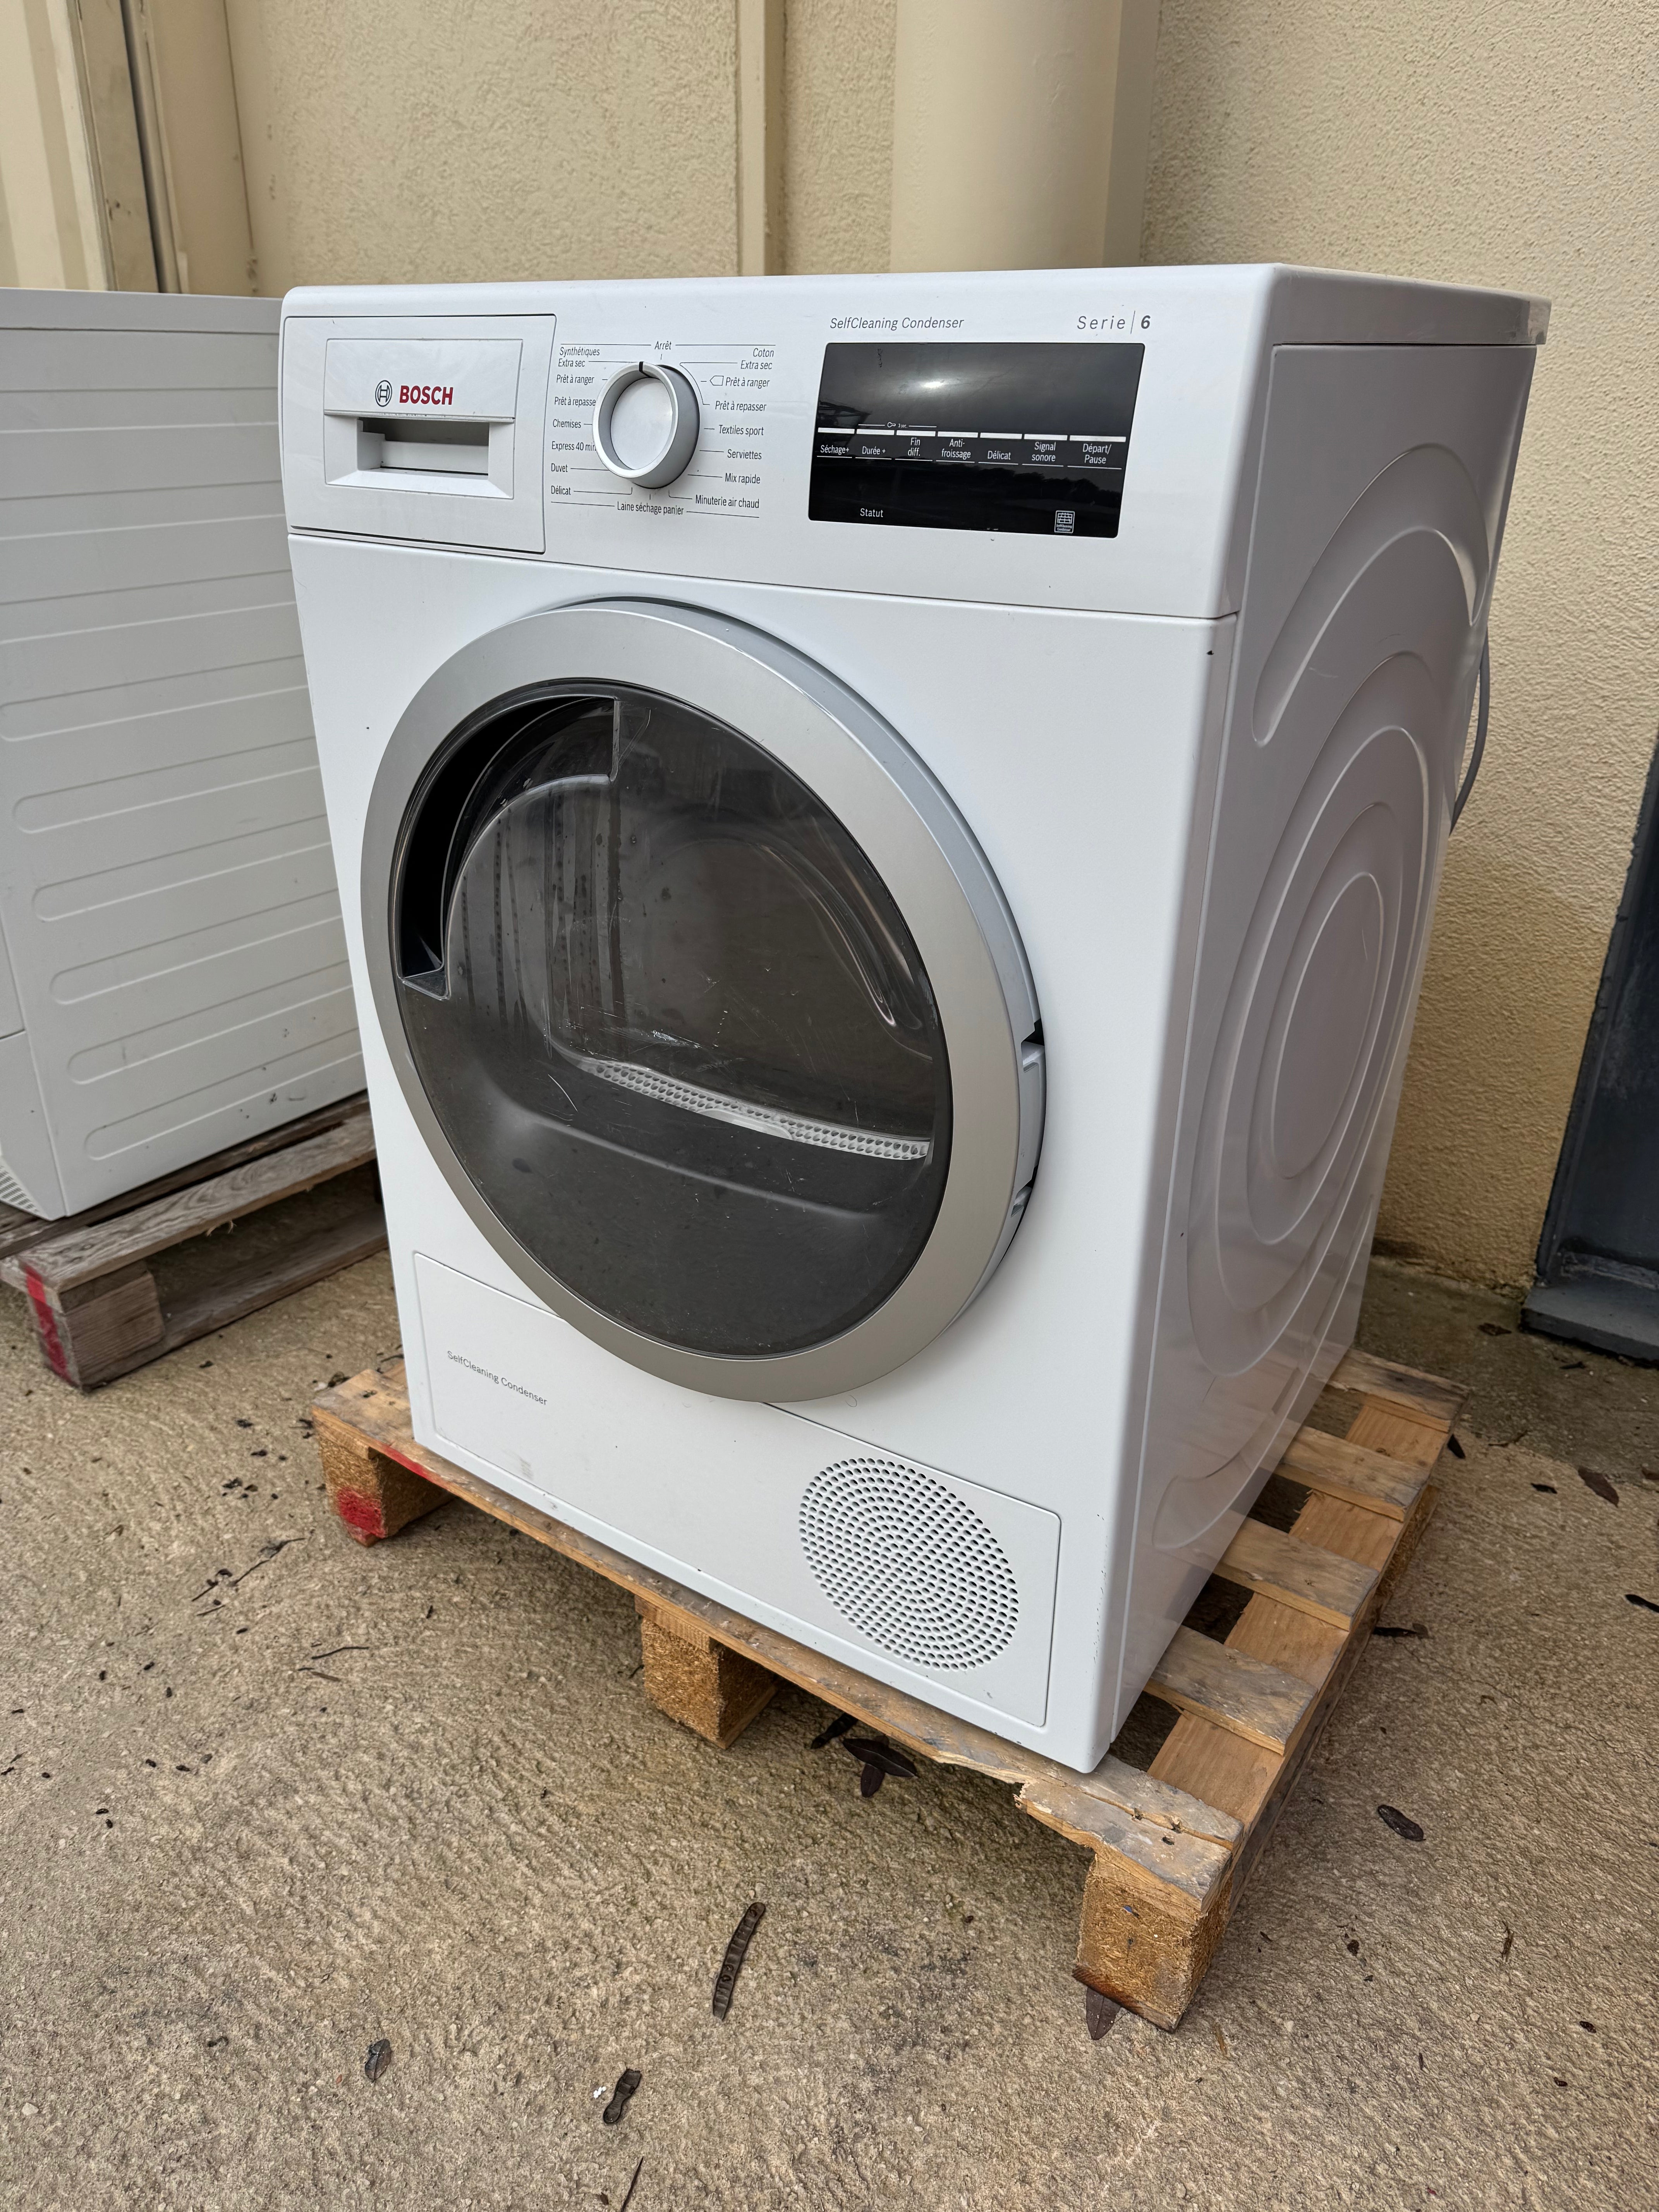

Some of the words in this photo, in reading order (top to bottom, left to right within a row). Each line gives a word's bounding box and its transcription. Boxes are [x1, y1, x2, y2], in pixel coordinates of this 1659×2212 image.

[830, 317, 898, 331] SelfCleaning
[902, 316, 965, 328] Condenser
[1077, 315, 1125, 330] Serie
[1140, 314, 1151, 330] 6
[654, 340, 672, 350] Arrêt
[560, 347, 600, 358] Synthétiques
[753, 348, 774, 357] Coton
[558, 358, 574, 367] Extra
[740, 360, 759, 369] Extra
[556, 374, 569, 383] Prêt
[570, 374, 574, 383] à
[575, 377, 594, 385] ranger
[725, 377, 740, 386] Prêt
[741, 377, 745, 386] à
[747, 380, 770, 389] ranger
[399, 385, 453, 405] BOSCH
[554, 396, 567, 405] Prêt
[567, 396, 571, 405] à
[572, 399, 596, 408] repasse
[715, 400, 730, 410] Prêt
[730, 400, 735, 410] à
[736, 403, 767, 412] repasser
[553, 419, 581, 428] Chemises
[719, 424, 744, 435] Textiles
[745, 427, 764, 437] sport
[552, 441, 575, 452] Express
[575, 442, 584, 451] 40
[910, 437, 920, 446] Fin
[949, 438, 965, 447] Anti-
[1034, 441, 1056, 452] Signal
[820, 445, 850, 455] Séchage+
[862, 446, 881, 455] Durée
[908, 447, 921, 456] diff.
[941, 448, 971, 460] froissage
[1082, 443, 1112, 454] Départ/
[727, 449, 762, 460] Serviettes
[988, 450, 1011, 460] Délicat
[1084, 454, 1106, 464] Pause
[551, 463, 568, 472] Duvet
[725, 474, 737, 483] Mix
[738, 474, 761, 485] rapide
[551, 485, 571, 495] Délicat
[696, 494, 726, 506] Minuterie
[728, 497, 737, 507] air
[738, 497, 759, 508] chaud
[617, 501, 634, 511] Laine
[635, 502, 662, 515] séchage
[663, 505, 684, 515] panier
[860, 508, 883, 517] Statut
[447, 1350, 499, 1384] SelfCleaning
[501, 1377, 548, 1405] Condenser
